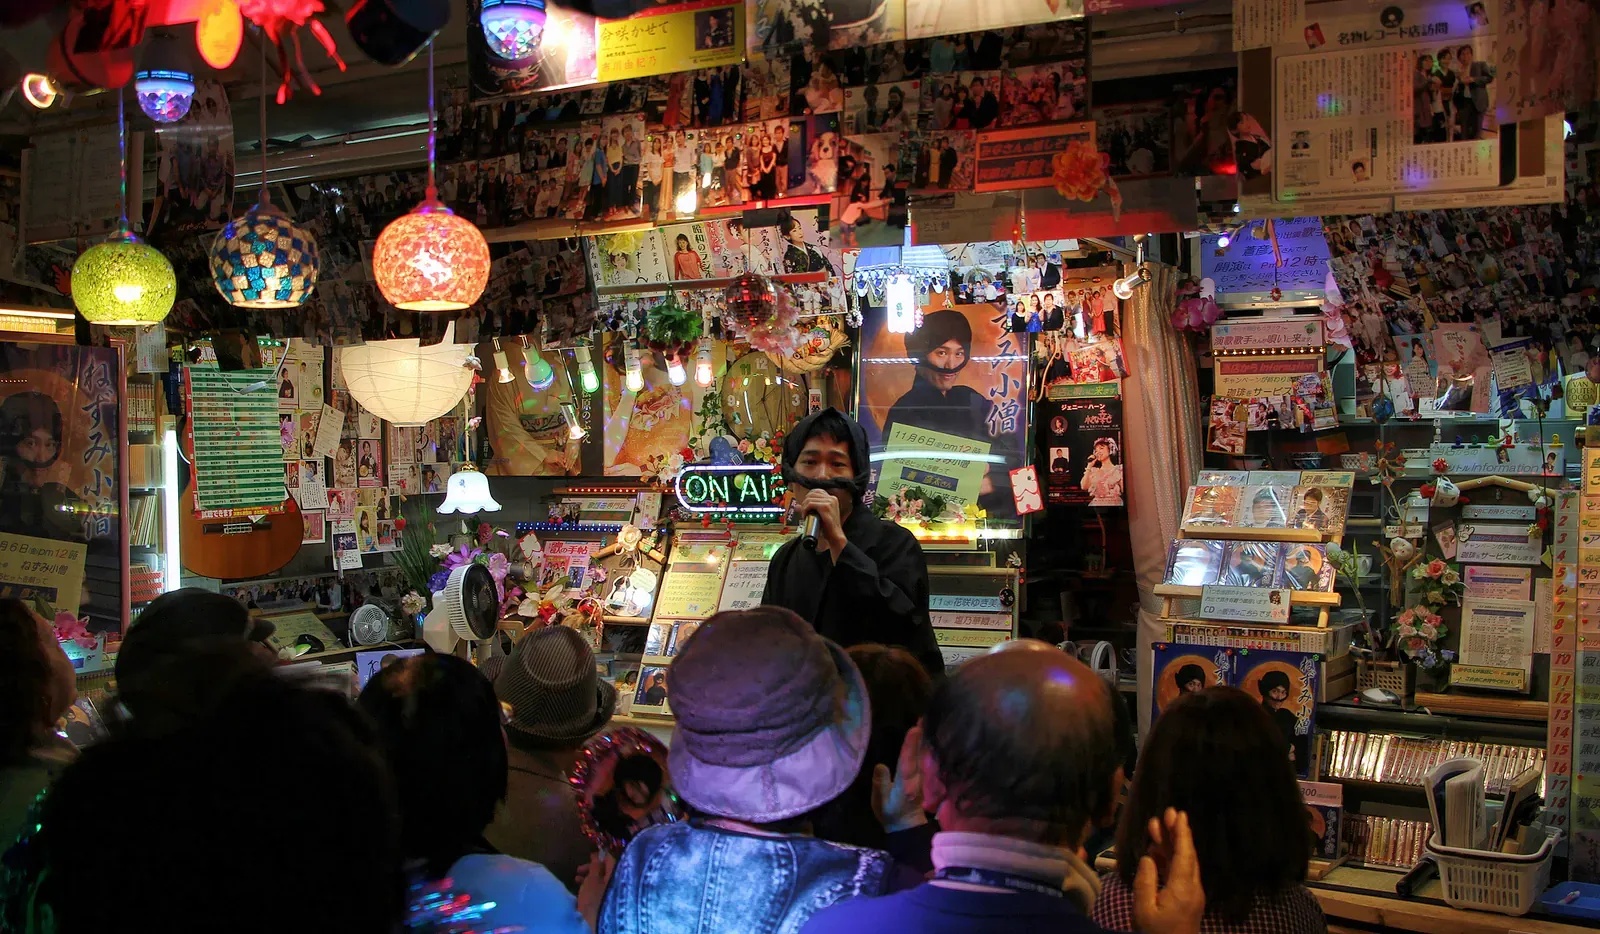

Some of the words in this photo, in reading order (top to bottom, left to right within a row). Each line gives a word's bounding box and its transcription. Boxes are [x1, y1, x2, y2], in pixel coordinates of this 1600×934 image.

[1338, 22, 1449, 45] 名物レコード店訪問
[755, 358, 768, 370] 12
[791, 393, 800, 406] 3
[82, 361, 114, 540] ねずみ小僧
[686, 475, 729, 502] ON
[1557, 515, 1568, 527] 2
[1557, 532, 1568, 544] 3
[550, 541, 588, 555] 歌の手帖
[1555, 549, 1567, 561] 4
[1555, 567, 1566, 579] 5
[1203, 605, 1216, 614] CD
[1555, 601, 1565, 613] 7
[1554, 618, 1564, 630] 8
[1554, 636, 1563, 647] 9
[1554, 653, 1571, 665] 10
[1213, 651, 1230, 687] ねず
[1554, 674, 1571, 686] 11
[1294, 655, 1316, 736] ねずみ小僧
[1554, 692, 1571, 704] 12
[1553, 709, 1571, 721] 13
[1552, 726, 1570, 738] 14
[1552, 743, 1570, 756] 15
[1551, 761, 1568, 774] 16
[1551, 779, 1568, 791] 17
[1550, 797, 1567, 809] 18
[1550, 813, 1567, 826] 19
